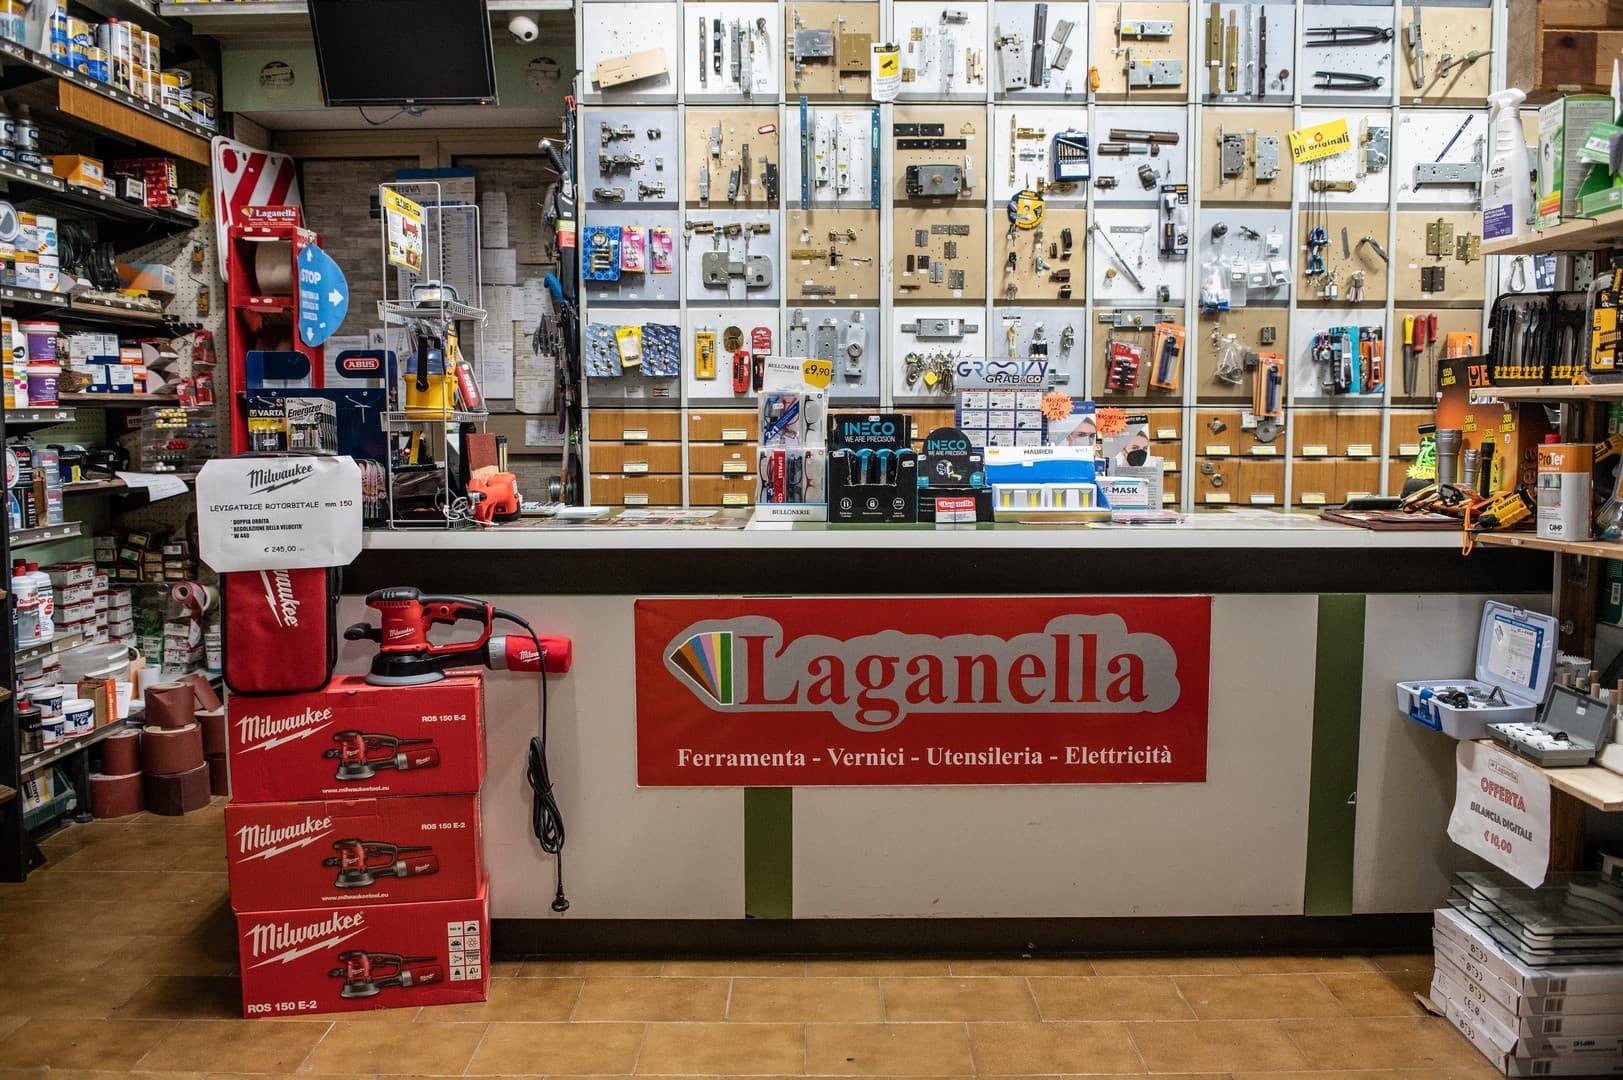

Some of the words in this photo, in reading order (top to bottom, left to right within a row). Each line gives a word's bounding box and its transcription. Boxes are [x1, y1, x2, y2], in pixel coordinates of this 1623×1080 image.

[1294, 145, 1306, 158] gli
[1309, 131, 1350, 150] originali
[256, 209, 296, 218] Laganella
[301, 269, 321, 284] STOP
[349, 359, 376, 369] ABUS
[805, 364, 830, 376] €9,90
[257, 409, 284, 417] VARTA
[288, 404, 323, 418] Energizer
[845, 422, 895, 435] INECO
[928, 440, 967, 451] INECO
[1539, 452, 1565, 467] ProTer
[246, 463, 314, 488] Milwaukee
[210, 504, 263, 512] LEVIGATRICE
[266, 501, 319, 510] ROTORBITALE
[274, 569, 299, 627] waukee
[738, 632, 1149, 727] Laganella
[74, 718, 89, 728] K2
[235, 707, 333, 744] Milwaukee
[677, 749, 806, 767] Ferramenta
[827, 748, 904, 766] Vernici
[927, 747, 1043, 765] Utensileria
[1065, 745, 1172, 765] Elettricità
[322, 785, 390, 793] www.milwaukeetool.eu
[1480, 776, 1526, 813] OFFERTA
[1470, 801, 1501, 825] BILANCIA
[1502, 818, 1533, 842] DIGITALE
[234, 816, 332, 854] Milwaukee
[1484, 830, 1490, 842] €
[1490, 832, 1512, 854] 10,00
[321, 893, 389, 901] www.milwaukeetool.eu
[244, 911, 365, 957] Milwaukee
[248, 1004, 271, 1013] ROS
[275, 1002, 295, 1011] 150
[298, 1000, 317, 1010] E-2
